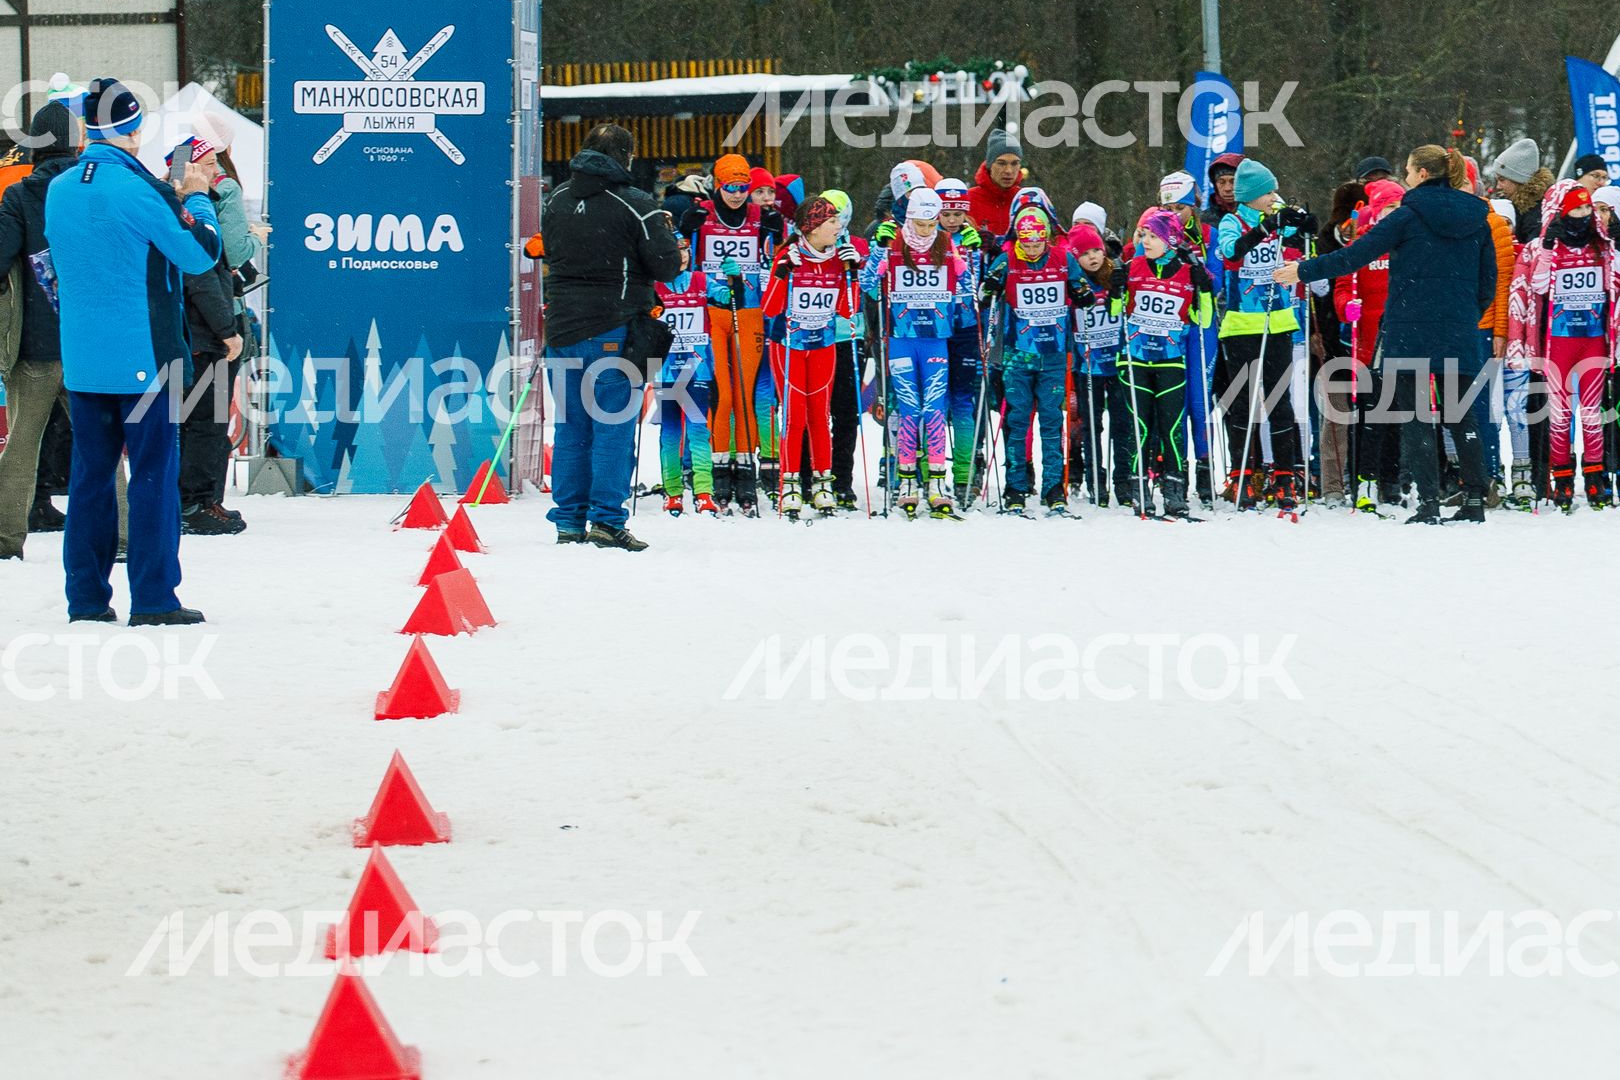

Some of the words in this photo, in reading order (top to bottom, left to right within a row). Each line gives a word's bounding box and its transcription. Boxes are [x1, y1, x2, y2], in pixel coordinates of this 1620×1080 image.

[381, 55, 398, 69] 54
[301, 87, 478, 108] МАНЖОСОВСКАЯ
[363, 116, 416, 130] ЛЫЖНЯ
[362, 146, 414, 155] ОСНОВАНА
[304, 213, 465, 253] ЗИМА
[713, 240, 750, 258] 925
[328, 261, 337, 269] в
[341, 257, 439, 272] Подмосковье
[902, 270, 940, 288] 985
[1562, 271, 1596, 290] 930
[798, 292, 834, 310] 940
[1022, 286, 1058, 305] 989
[1139, 295, 1176, 315] 962
[665, 312, 695, 331] 917
